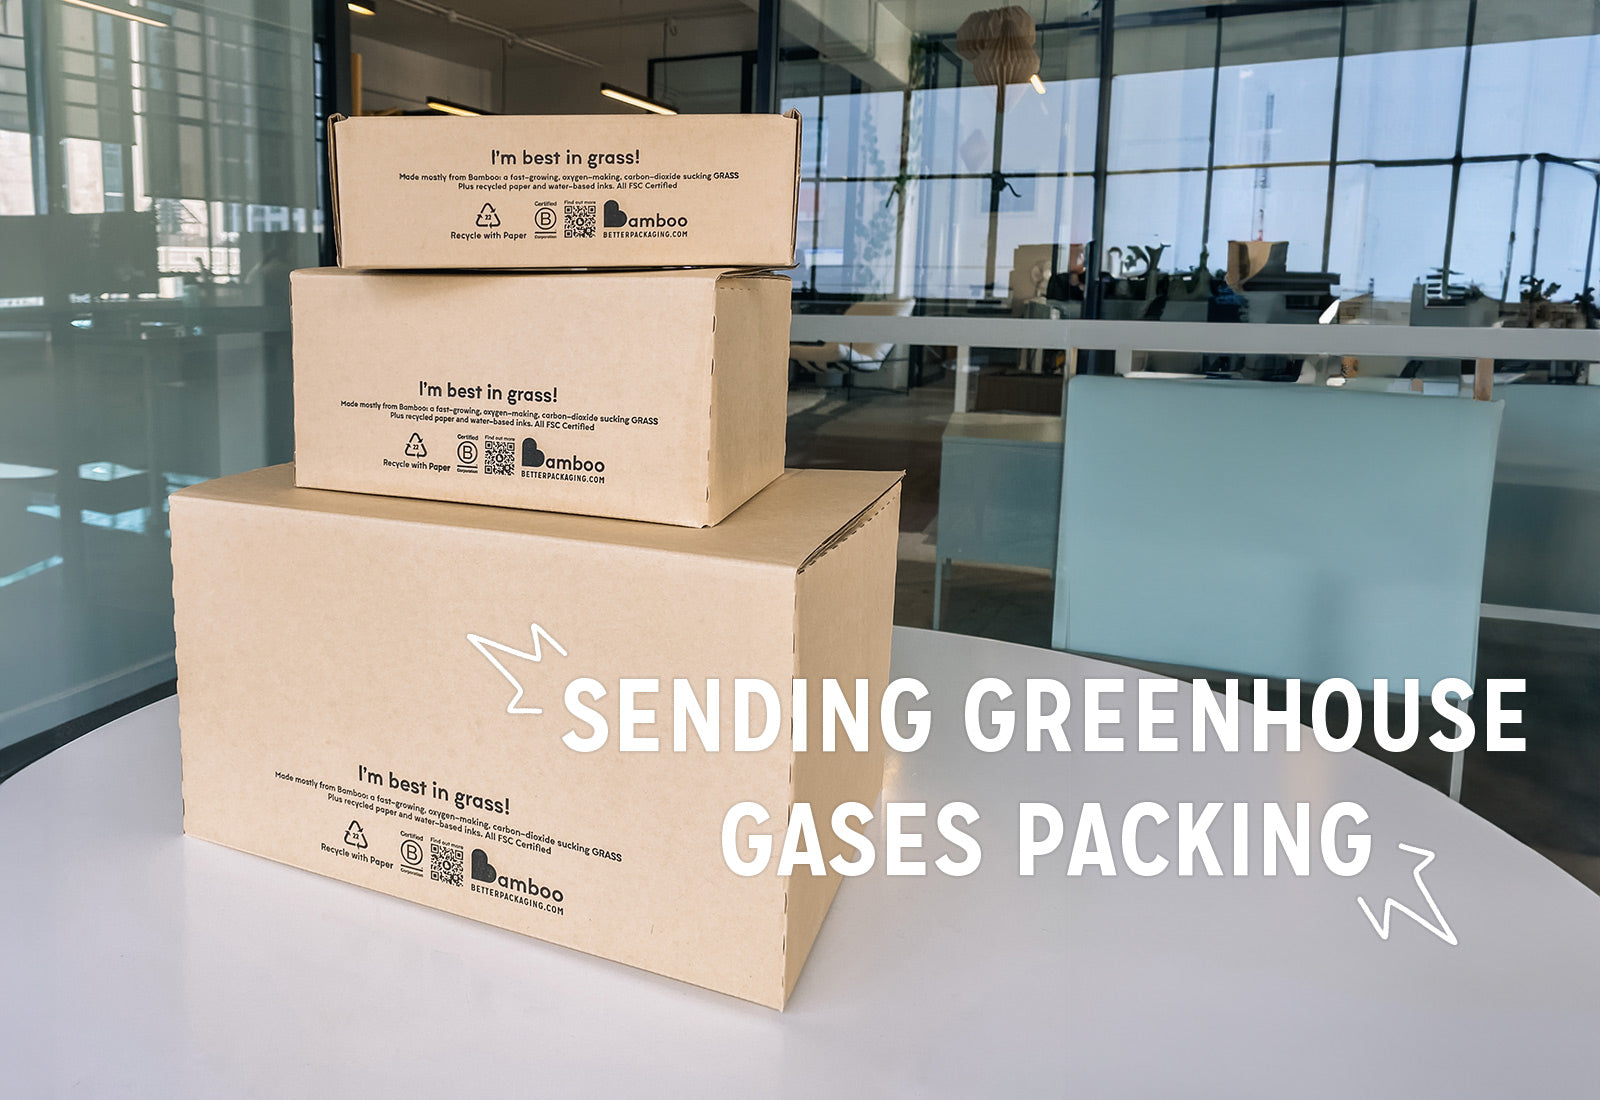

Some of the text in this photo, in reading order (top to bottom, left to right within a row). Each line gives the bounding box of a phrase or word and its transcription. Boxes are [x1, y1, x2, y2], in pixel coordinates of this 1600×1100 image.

[491, 149, 640, 169] I'm best in grass!
[398, 173, 420, 181] Made
[421, 173, 447, 183] mostly
[448, 173, 467, 181] from
[682, 171, 712, 181] sucking
[713, 171, 740, 180] GRASS
[458, 182, 474, 190] Plus
[475, 182, 507, 192] recycled
[532, 182, 547, 190] and
[628, 181, 643, 190] FSC
[644, 181, 678, 189] Certified
[450, 231, 527, 241] Recycle with Paper
[602, 230, 688, 239] BETTERPACKAGING.COM
[419, 381, 558, 403] I'm best in grass!
[340, 400, 359, 408] Made
[359, 401, 382, 411] mostly
[382, 402, 398, 413] from
[599, 414, 630, 425] sucking
[630, 416, 659, 426] GRASS
[390, 411, 404, 419] Plus
[405, 413, 434, 422] recycled
[434, 415, 455, 424] paper
[534, 420, 545, 428] All
[546, 420, 561, 429] FSC
[561, 421, 595, 431] Certified
[456, 433, 479, 441] Certified
[383, 458, 451, 473] Recycle with Paper
[520, 470, 605, 484] BETTERPACKAGING.COM
[358, 764, 510, 816] I'm best in grass!
[274, 771, 294, 782] Made
[294, 777, 318, 789] mostly
[319, 781, 336, 795] from
[369, 795, 375, 804] a
[557, 840, 591, 855] sucking
[591, 847, 622, 862] GRASS
[327, 794, 343, 803] Plus
[344, 798, 374, 811] recycled
[375, 806, 397, 816] paper
[398, 811, 413, 820] and
[484, 831, 496, 841] All
[497, 833, 514, 845] FSC
[515, 838, 552, 855] Certified
[399, 830, 424, 842] Certified
[320, 842, 394, 869] Recycle with Paper
[470, 883, 564, 916] BETTERPACKAGING.COM
